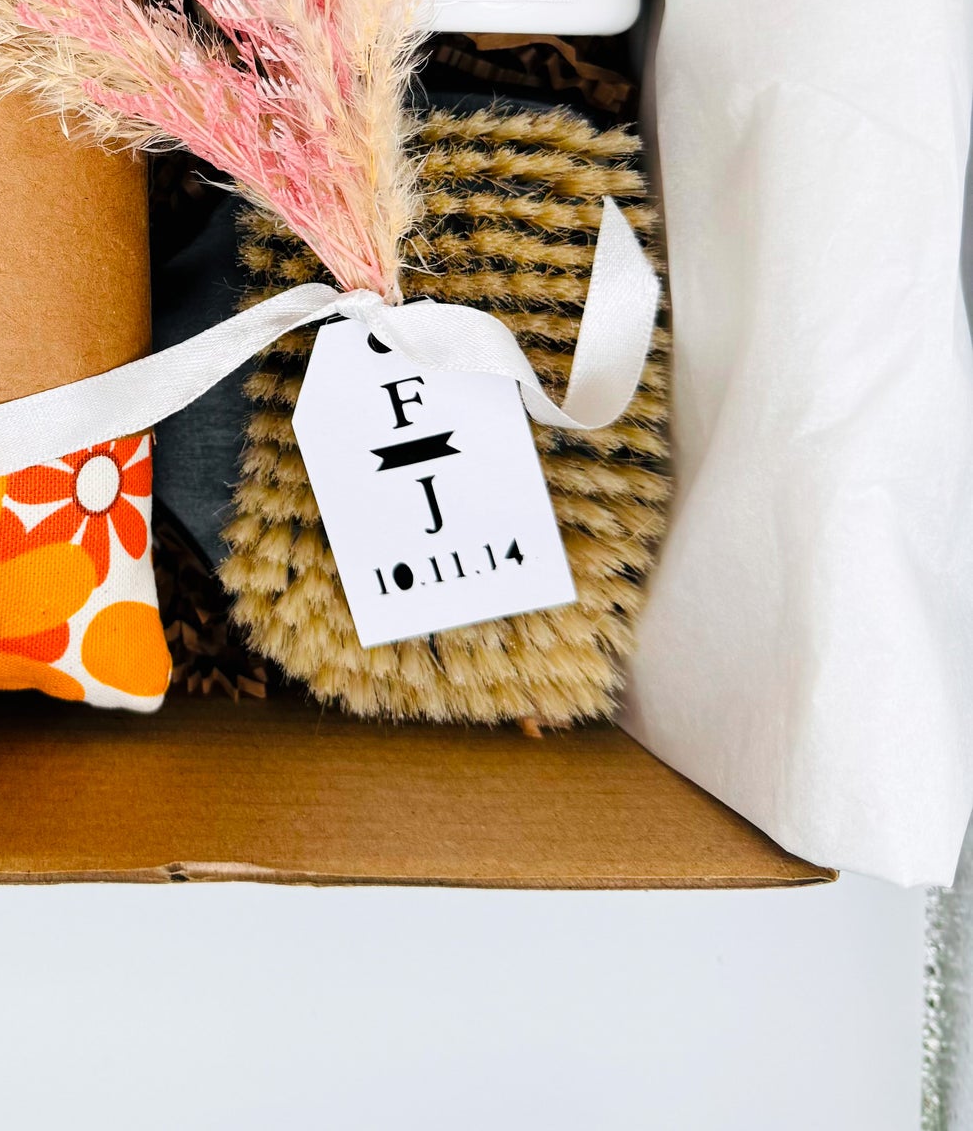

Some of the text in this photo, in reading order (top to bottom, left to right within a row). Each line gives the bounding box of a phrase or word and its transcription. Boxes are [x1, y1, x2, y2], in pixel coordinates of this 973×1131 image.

[380, 375, 425, 429] F
[415, 474, 444, 535] J
[373, 537, 525, 595] 10.11.14
